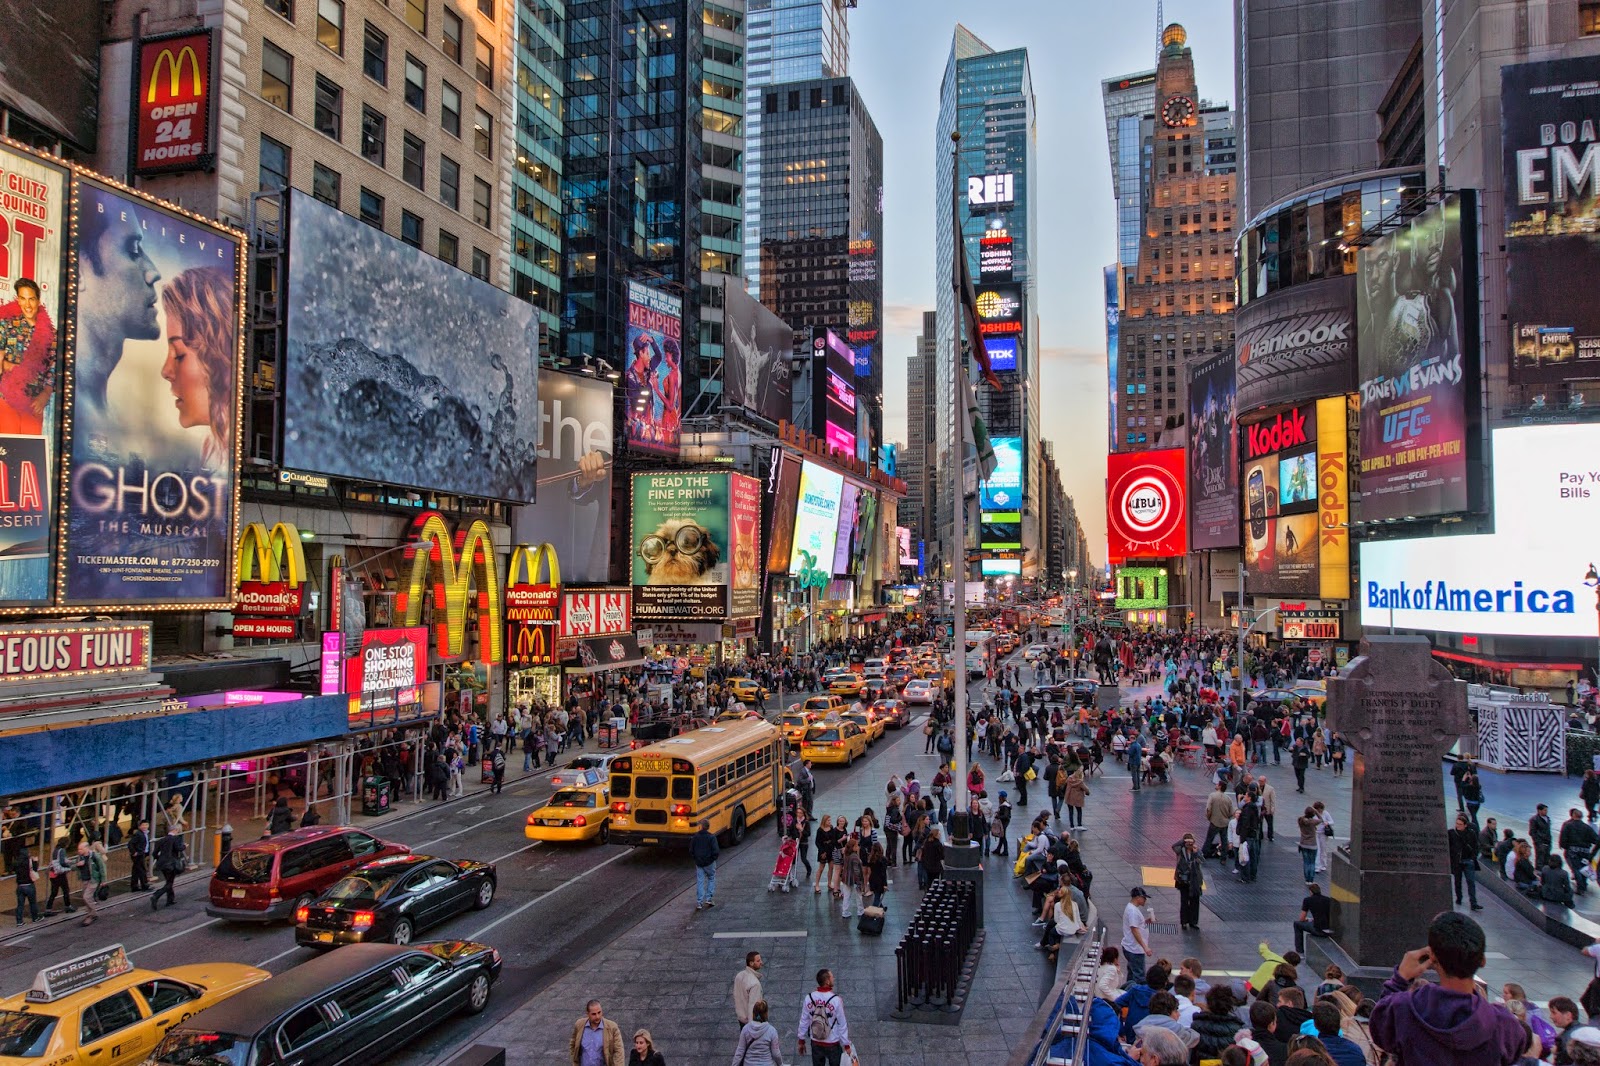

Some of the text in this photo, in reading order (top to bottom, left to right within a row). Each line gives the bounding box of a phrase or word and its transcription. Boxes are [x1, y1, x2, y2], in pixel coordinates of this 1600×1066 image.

[151, 102, 198, 120] OPEN
[155, 118, 191, 143] 24
[1541, 120, 1600, 145] BOA
[143, 142, 202, 162] HOURS
[9, 173, 47, 201] GLITZ
[968, 174, 1014, 204] REI
[0, 191, 46, 220] QUINED
[97, 202, 225, 259] BELIEVE
[985, 230, 1007, 238] 2012
[630, 290, 681, 317] BEST MUSICAL
[630, 304, 681, 338] MEMPHIS
[1542, 335, 1572, 344] EMPIRE
[814, 349, 825, 357] LG
[988, 349, 1013, 358] TDK
[1260, 341, 1348, 365] driving emotion
[1409, 354, 1463, 389] EVANS
[1360, 377, 1397, 405] JONES
[1249, 407, 1306, 458] Kodak
[1383, 406, 1424, 443] UFC
[1371, 456, 1385, 470] APRIL
[1396, 450, 1407, 465] LIVE
[1416, 440, 1461, 461] PAY-PER-VIEW
[651, 476, 709, 488] READ THE
[1560, 472, 1584, 485] Pay
[75, 463, 229, 521] GHOST
[648, 488, 712, 499] FINE PRINT
[1320, 451, 1345, 547] Kodak
[1560, 487, 1591, 498] Bills
[0, 515, 43, 527] SERT
[99, 520, 208, 538] THE MUSICAL
[77, 555, 158, 566] TICKETMASTER.COM
[171, 558, 220, 567] 877-250-2929
[237, 591, 298, 604] McDonald's
[506, 590, 558, 599] McDonald's
[1368, 581, 1575, 614] Bank of America
[242, 604, 287, 612] Restaurant
[635, 606, 725, 614] HUMANEWATCH.ORG
[234, 624, 292, 633] OPEN 24 HOURS
[1305, 623, 1336, 637] EVITA
[0, 632, 132, 674] EOUS FUN!
[366, 645, 413, 660] ONE STOP
[364, 657, 414, 673] SHOPPING
[365, 668, 413, 681] FOR ALL THINGS
[363, 676, 414, 692] BROADWAY
[1360, 698, 1399, 708] FRANCIS
[1410, 699, 1442, 708] DUFFY
[635, 760, 671, 770] SCHOOL BUS
[73, 972, 86, 980] LIVE
[86, 966, 104, 977] MUSIC
